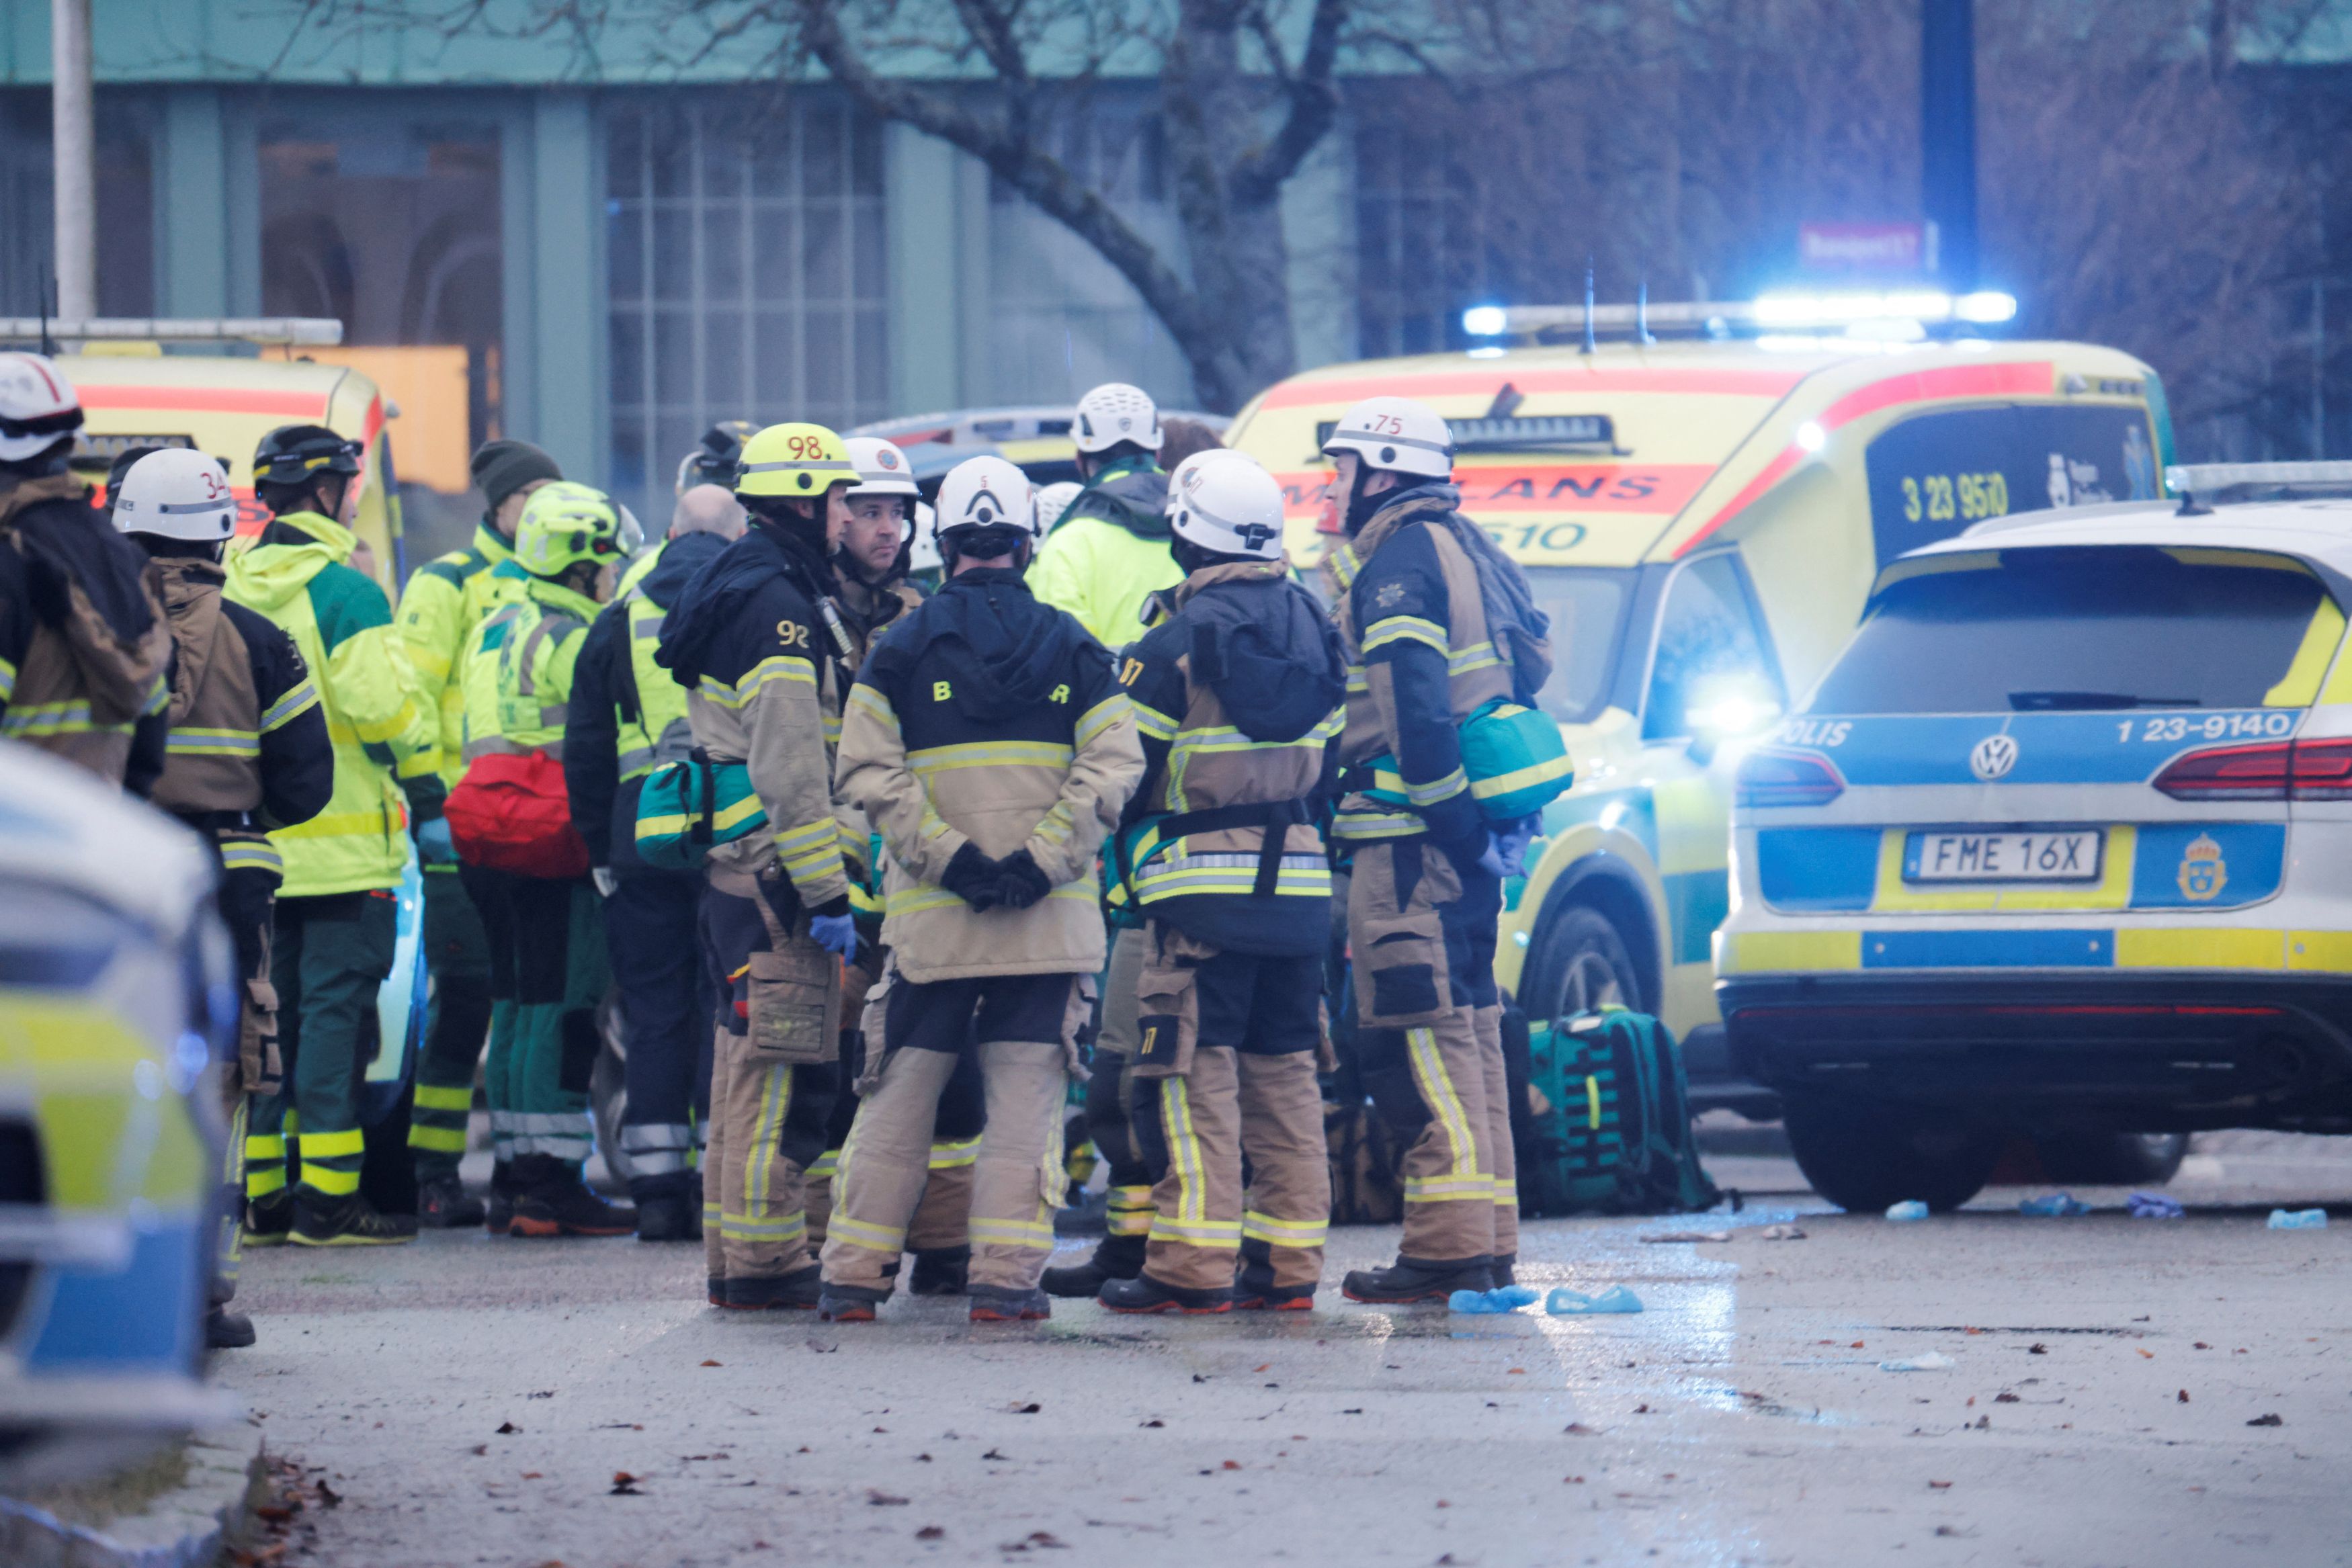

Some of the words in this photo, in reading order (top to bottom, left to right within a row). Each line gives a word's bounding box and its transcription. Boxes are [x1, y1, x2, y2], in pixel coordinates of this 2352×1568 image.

[1374, 413, 1404, 435] 75
[788, 435, 823, 460] 98
[1902, 476, 1922, 521] 3
[1925, 474, 1956, 521] 23
[2117, 720, 2134, 743] 1
[2142, 713, 2290, 742] 23-9140
[1934, 838, 2003, 872] FME
[2020, 836, 2083, 872] 16X
